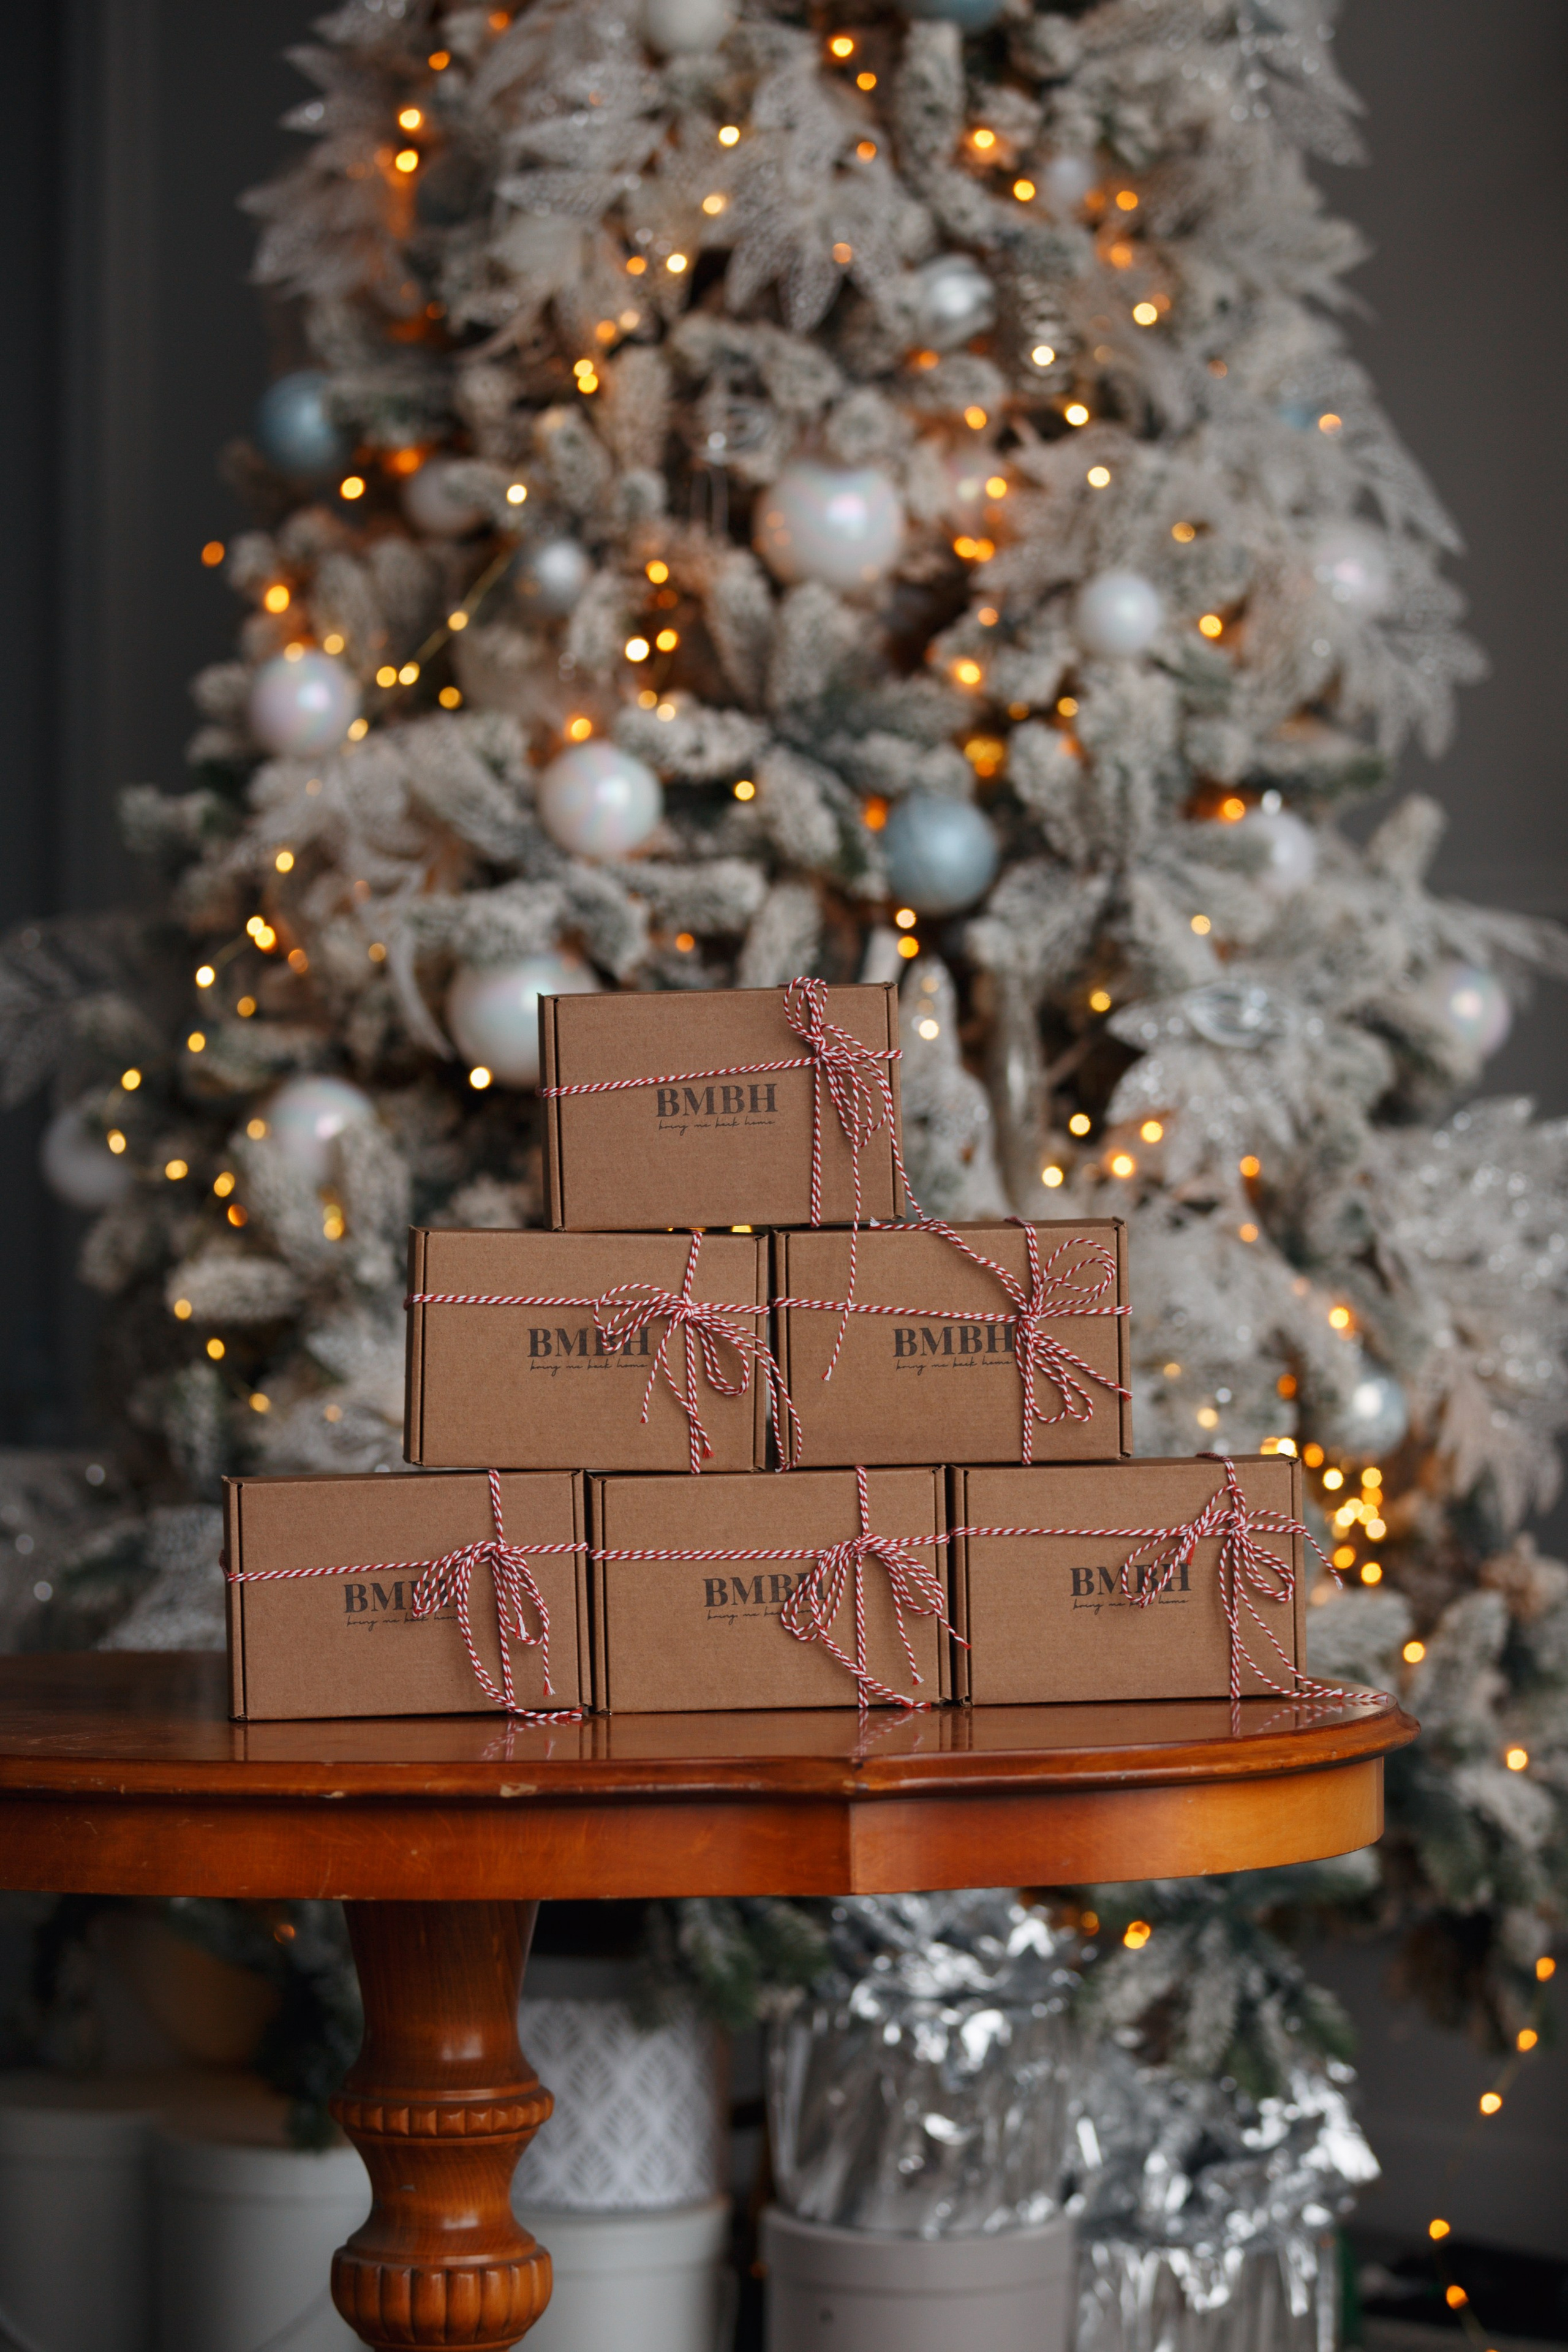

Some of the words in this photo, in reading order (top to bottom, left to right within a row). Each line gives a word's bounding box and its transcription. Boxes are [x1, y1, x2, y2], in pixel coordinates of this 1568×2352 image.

[656, 1084, 778, 1117] BMBH
[527, 1327, 650, 1357] BMBH
[893, 1324, 1016, 1357] BMBH
[1070, 1562, 1191, 1596] BMBH
[434, 1611, 459, 1620] hom
